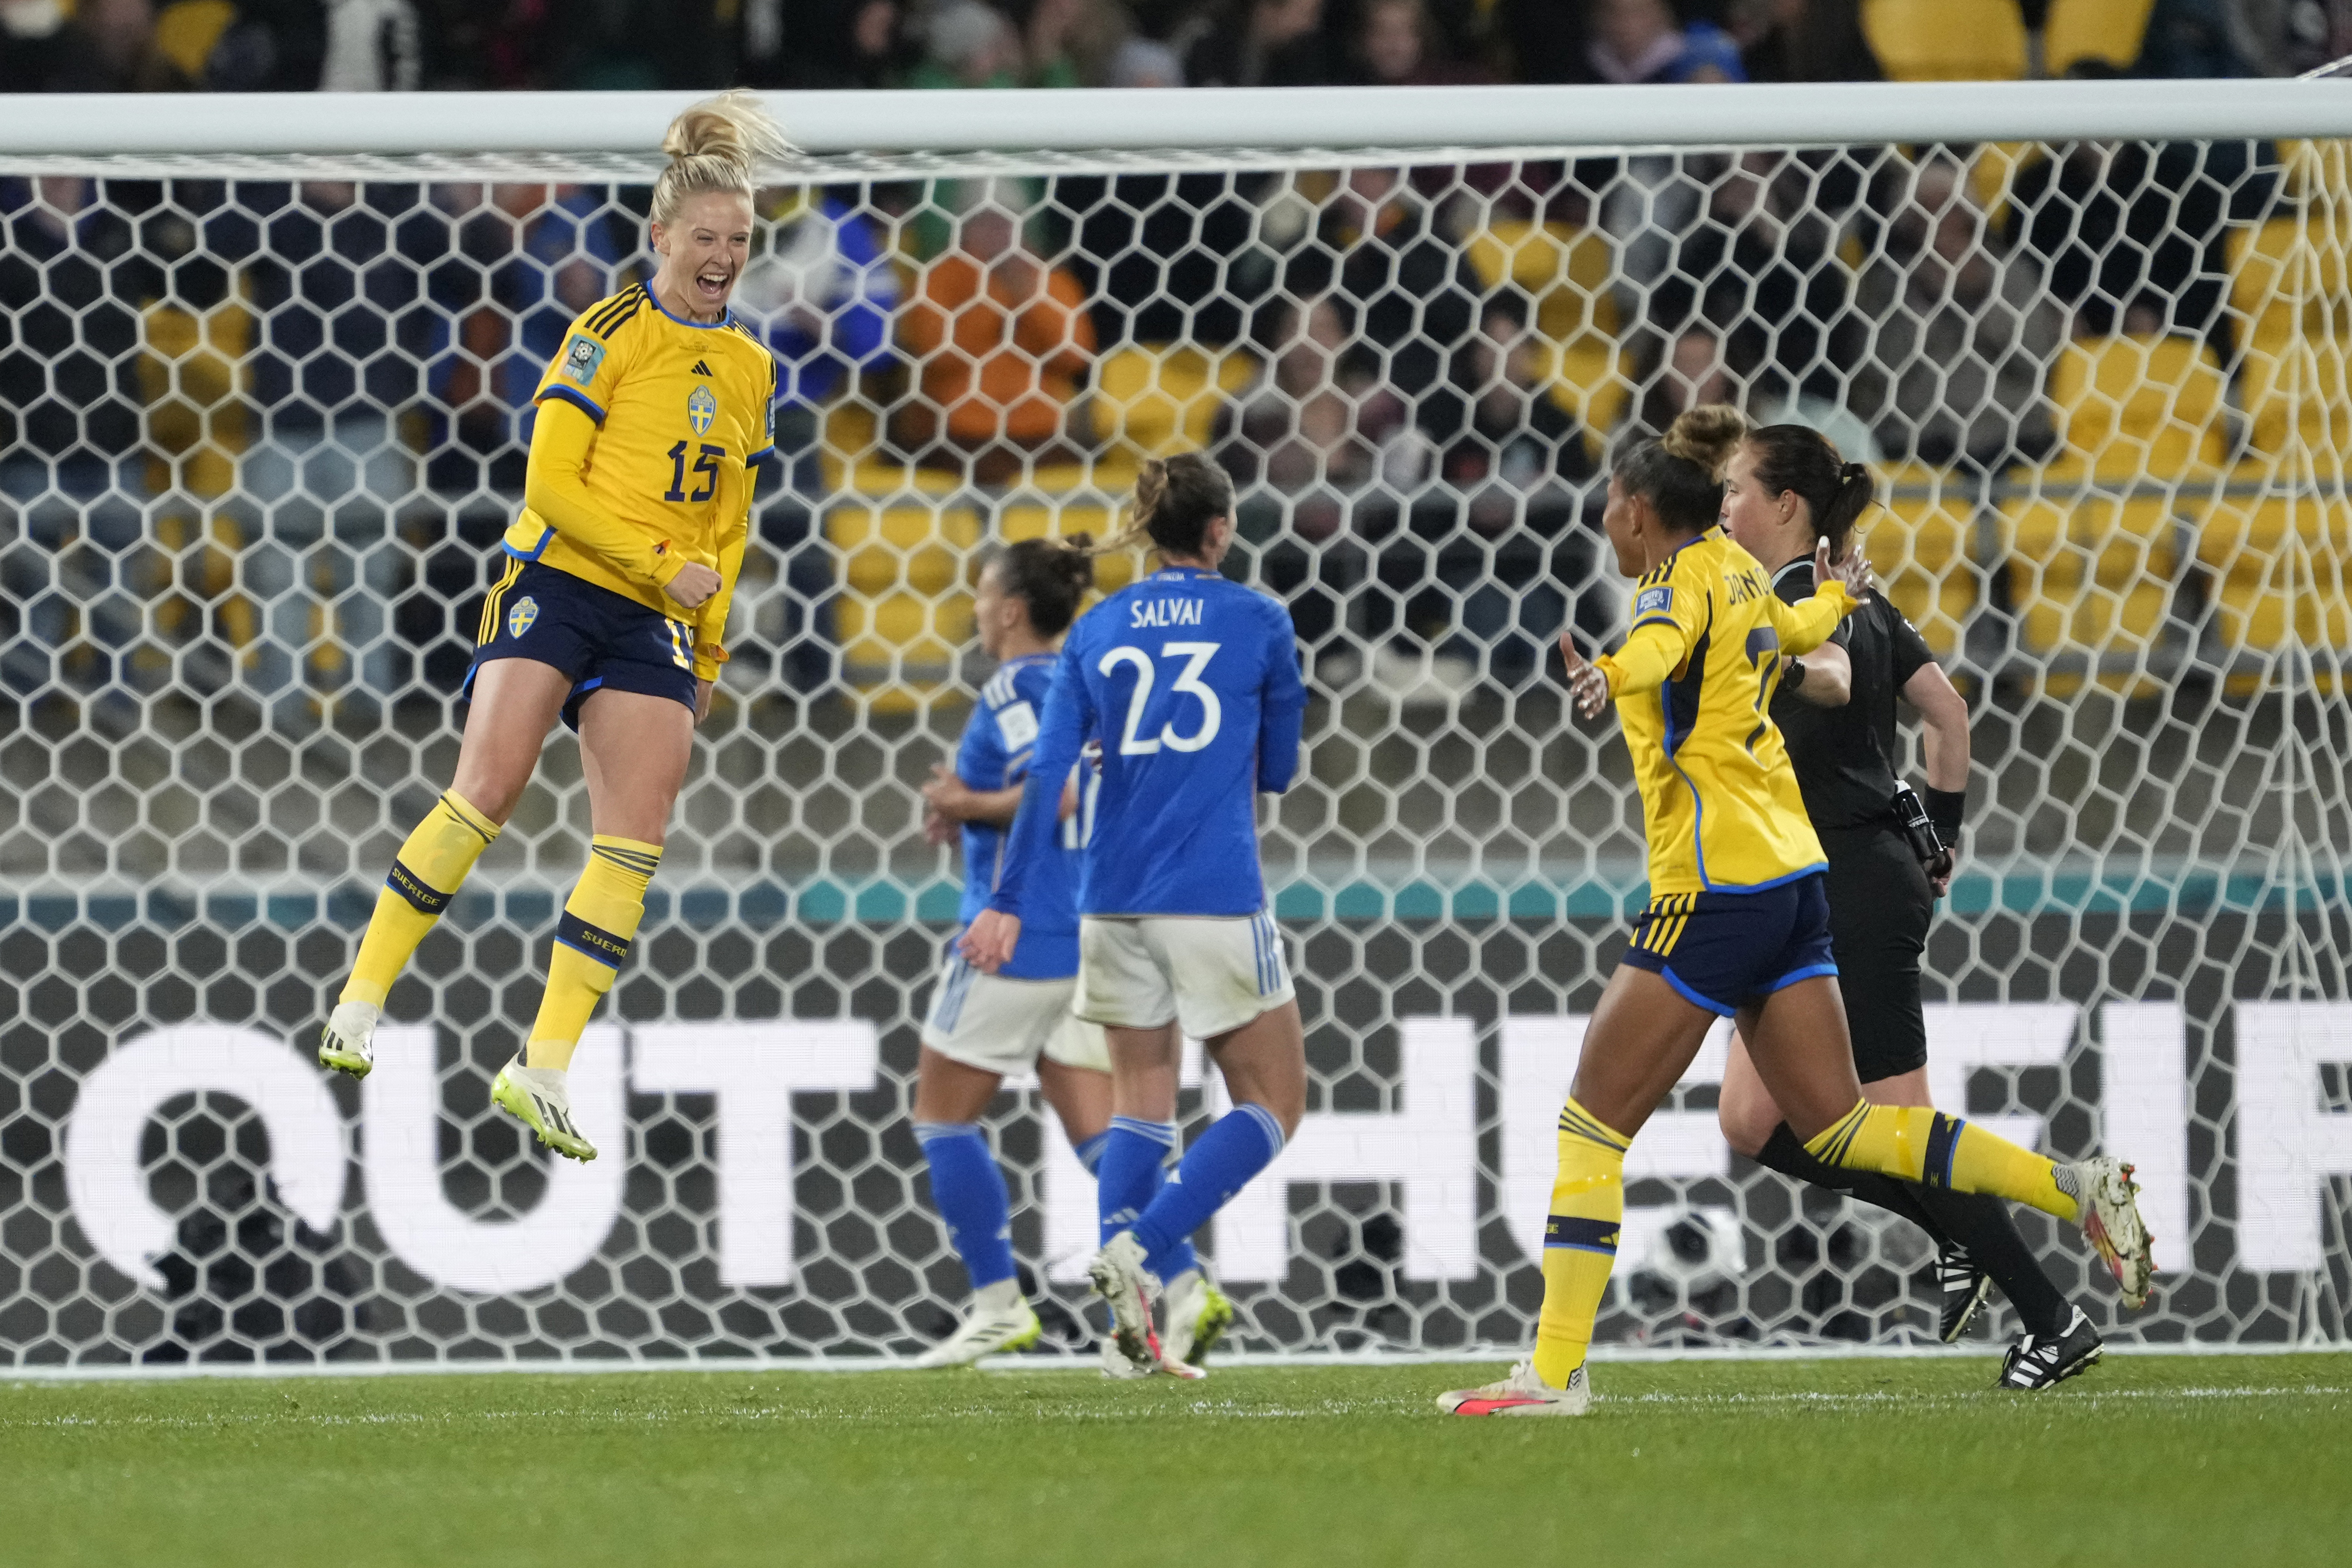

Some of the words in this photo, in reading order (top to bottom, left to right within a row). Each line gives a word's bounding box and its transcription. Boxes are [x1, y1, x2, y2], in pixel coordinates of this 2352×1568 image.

[665, 440, 726, 502] 15
[1131, 597, 1204, 628] SALVAI
[1098, 641, 1221, 755] 23
[65, 1021, 878, 1294] OUT
